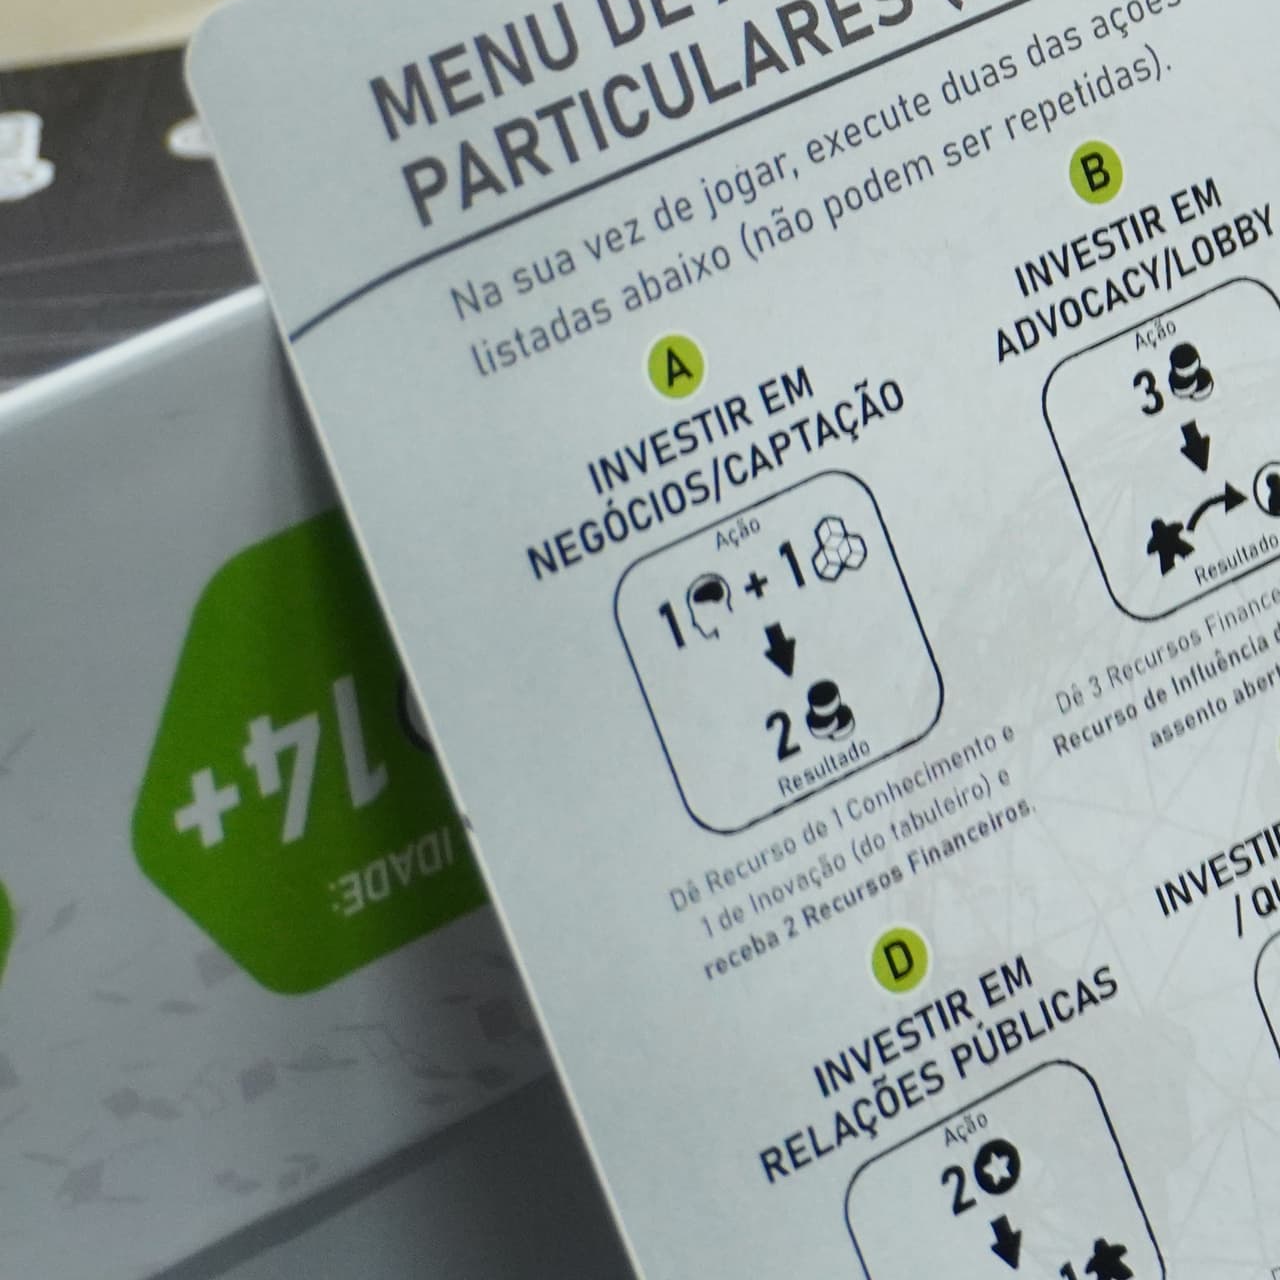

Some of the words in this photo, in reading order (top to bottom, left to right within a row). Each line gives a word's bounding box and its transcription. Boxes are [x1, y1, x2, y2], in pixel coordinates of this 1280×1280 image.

[369, 2, 579, 142] MENU
[450, 279, 504, 321] Na
[512, 248, 576, 295] sua
[583, 217, 646, 261] vez
[653, 195, 694, 232] de
[700, 152, 799, 221] jogar,
[806, 92, 932, 164] execute
[941, 55, 1018, 105] duas
[1026, 26, 1083, 68] das
[470, 297, 613, 377] listadas
[621, 245, 731, 313] abaixo
[740, 205, 814, 262] (não
[823, 154, 935, 231] podem
[942, 124, 993, 167] ser
[1004, 43, 1172, 141] repetidas).
[1079, 151, 1111, 193] B
[997, 203, 1274, 363] ADVOCACY/LOBBY
[1014, 204, 1167, 297] INVESTIR
[1170, 177, 1222, 225] EM
[666, 347, 694, 388] A
[1134, 319, 1178, 353] Ação
[588, 396, 753, 495] INVESTIR
[758, 365, 814, 416] EM
[1133, 369, 1165, 416] 3
[525, 378, 904, 581] NEGÓCIOS/CAPTAÇÃO
[716, 517, 761, 551] Ação
[1193, 533, 1280, 586] Resultado
[658, 601, 686, 649] 1
[779, 540, 806, 588] 1
[1052, 703, 1138, 757] Recurso
[1143, 687, 1168, 711] de
[1170, 635, 1270, 697] Influência
[1055, 683, 1085, 715] Dê
[1088, 674, 1103, 699] 3
[1105, 630, 1202, 689] Recursos
[174, 674, 390, 850] 14+
[765, 710, 801, 762] 2
[776, 737, 871, 798] Resultado
[1150, 697, 1228, 749] assento
[669, 879, 701, 913] Dê
[704, 837, 797, 895] Recurso
[802, 820, 828, 846] de
[846, 734, 997, 821] Conhecimento
[1001, 725, 1015, 743] e
[718, 905, 745, 932] de
[748, 853, 847, 915] Inovação
[851, 833, 886, 864] (do
[890, 773, 992, 841] tabuleiro)
[997, 768, 1010, 787] e
[328, 826, 455, 917] IDADE:
[1234, 893, 1243, 938] /
[703, 931, 780, 981] receba
[801, 865, 904, 929] Recursos
[883, 939, 914, 981] D
[759, 1060, 945, 1184] RELAÇÕES
[950, 965, 1118, 1079] PÚBLICAS
[813, 989, 975, 1098] INVESTIR
[979, 955, 1033, 1009] EM
[943, 1110, 990, 1150] Ação
[941, 1165, 977, 1216] 2
